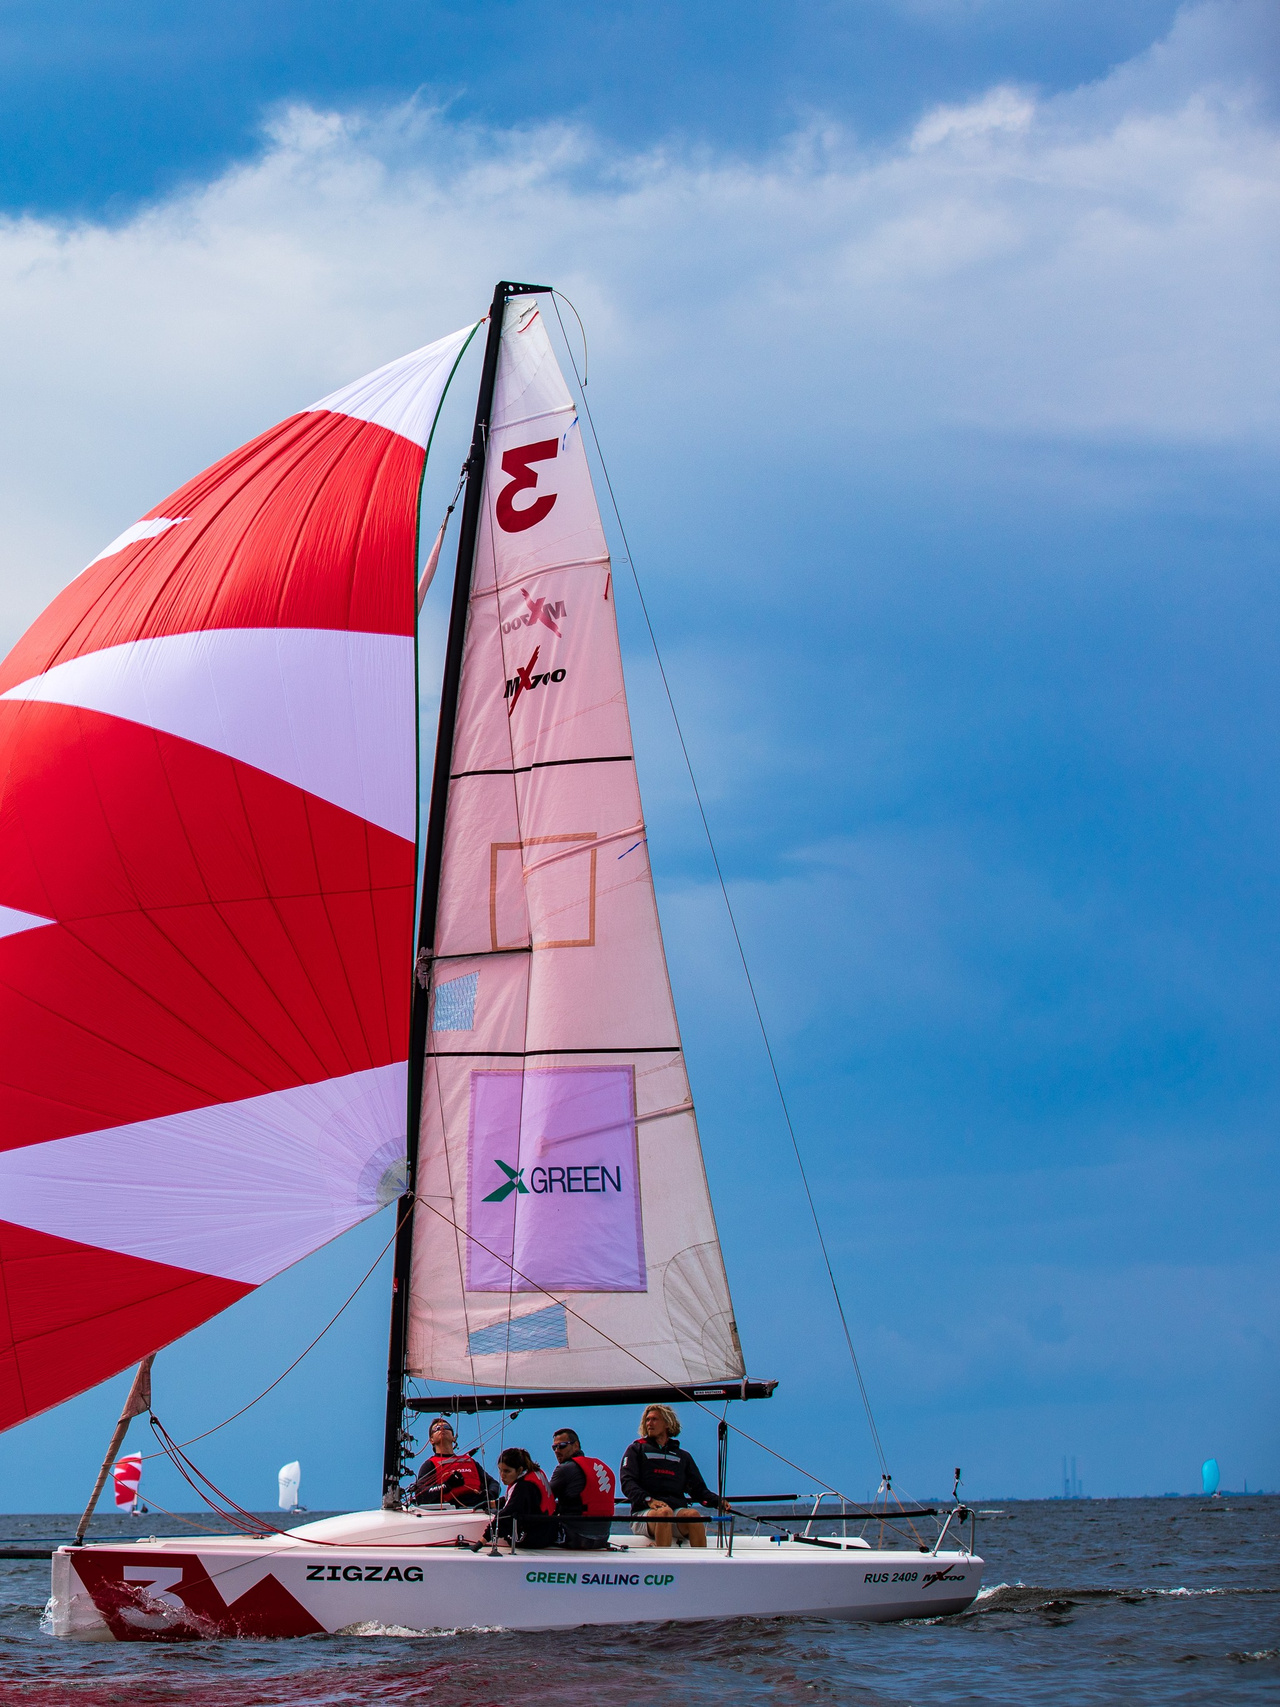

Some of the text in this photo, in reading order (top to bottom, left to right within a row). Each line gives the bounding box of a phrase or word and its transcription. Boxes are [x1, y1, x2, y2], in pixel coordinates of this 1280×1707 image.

[306, 1565, 424, 1582] ZIGZAG
[526, 1571, 674, 1586] GREEN SAILING CUP
[864, 1573, 889, 1583] RUS
[891, 1572, 918, 1582] 2409
[119, 1566, 185, 1630] 3
